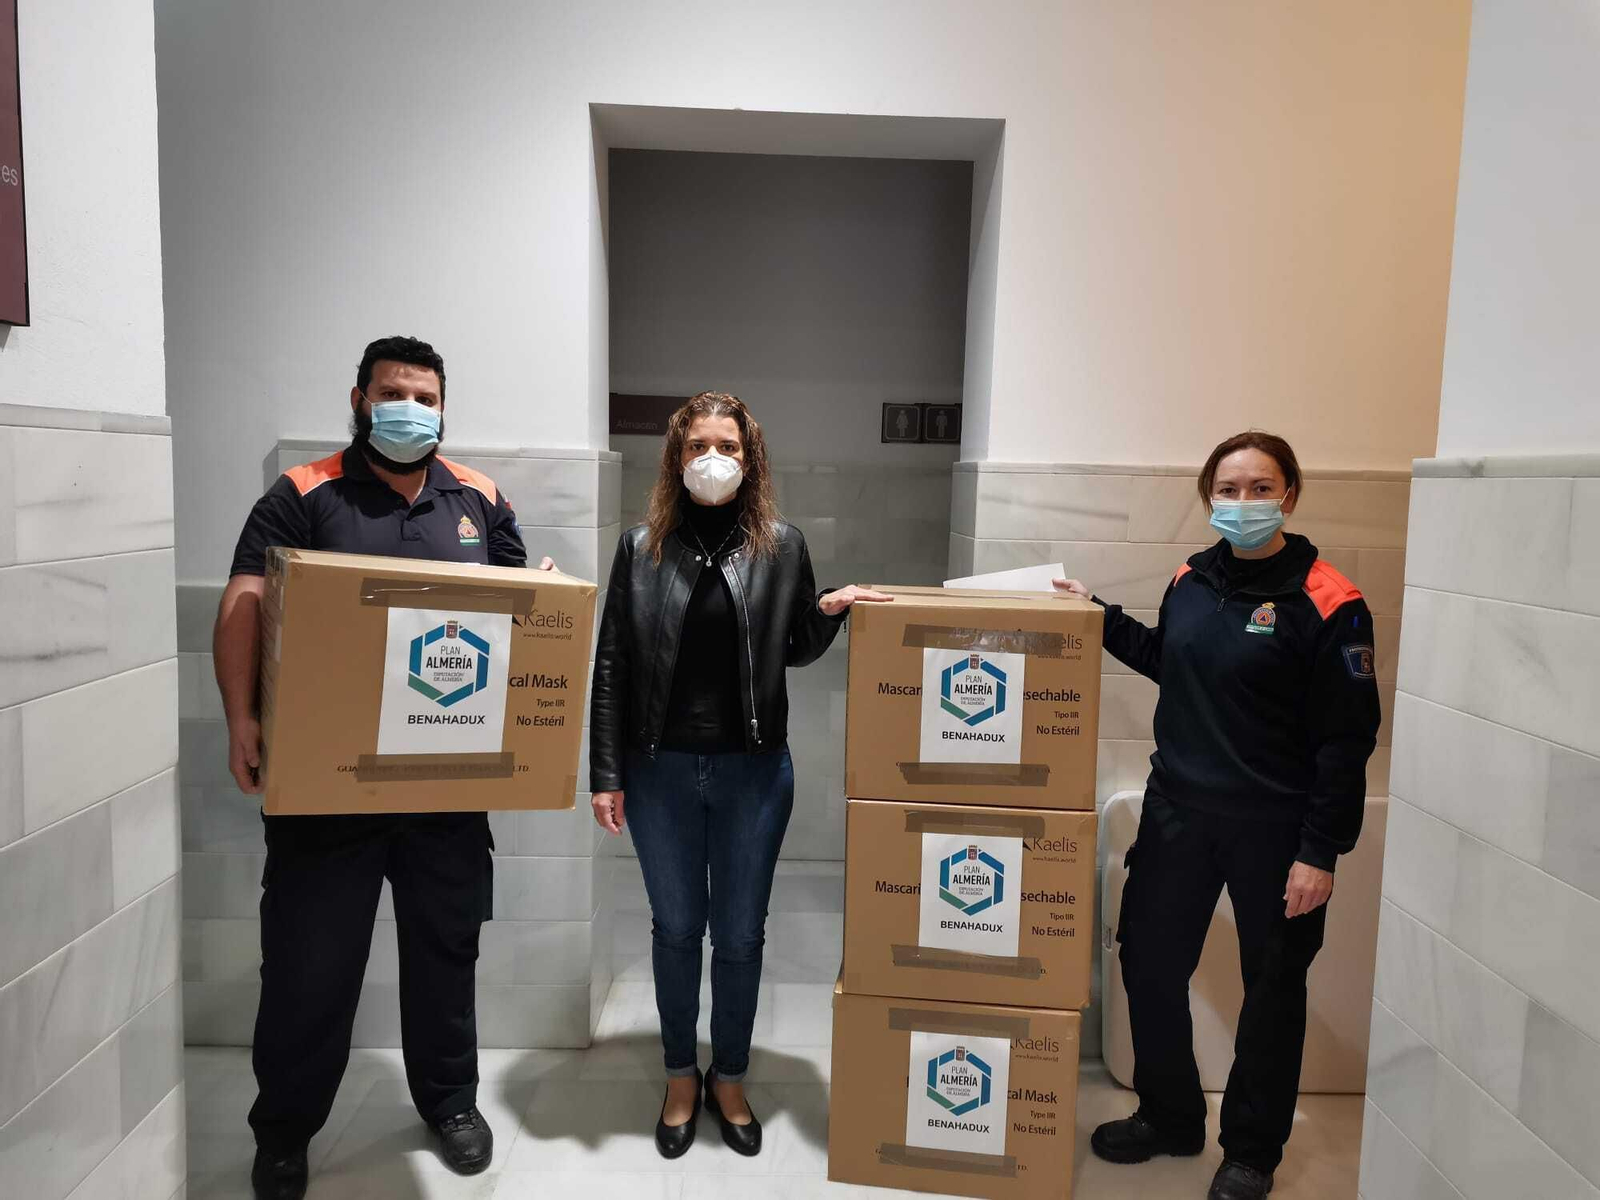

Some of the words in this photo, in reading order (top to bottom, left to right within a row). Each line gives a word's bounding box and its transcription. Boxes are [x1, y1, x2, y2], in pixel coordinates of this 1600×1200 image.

[523, 608, 574, 629] Kaelis
[440, 645, 461, 655] PLAN
[426, 654, 473, 670] ALMERÍA
[509, 673, 529, 688] cal
[531, 674, 569, 689] Mask
[965, 674, 982, 683] PLAN
[878, 682, 922, 696] Mascar
[954, 683, 993, 696] ALMERÍA
[536, 698, 554, 708] Type
[407, 714, 486, 725] BENAHADUX
[516, 715, 532, 726] No
[534, 716, 565, 727] Estéril
[1054, 710, 1070, 720] Tipo
[1036, 725, 1050, 735] No
[1052, 726, 1080, 736] Estéril
[942, 731, 1006, 743] BENAHADUX
[1032, 836, 1078, 853] Kaelis
[963, 866, 980, 874] PLAN
[952, 873, 990, 886] ALMERÍA
[1050, 913, 1064, 921] Tipo
[940, 920, 1003, 932] BENAHADUX
[1032, 926, 1045, 936] No
[1047, 926, 1075, 938] Estéril
[1015, 1036, 1059, 1052] Kaelis
[952, 1066, 968, 1074] PLAN
[940, 1074, 978, 1087] ALMERÍA
[1025, 1089, 1058, 1104] Mask
[1030, 1110, 1046, 1120] Type
[928, 1118, 990, 1134] BENAHADUX
[1014, 1123, 1026, 1133] No
[1028, 1124, 1056, 1136] Estéril
